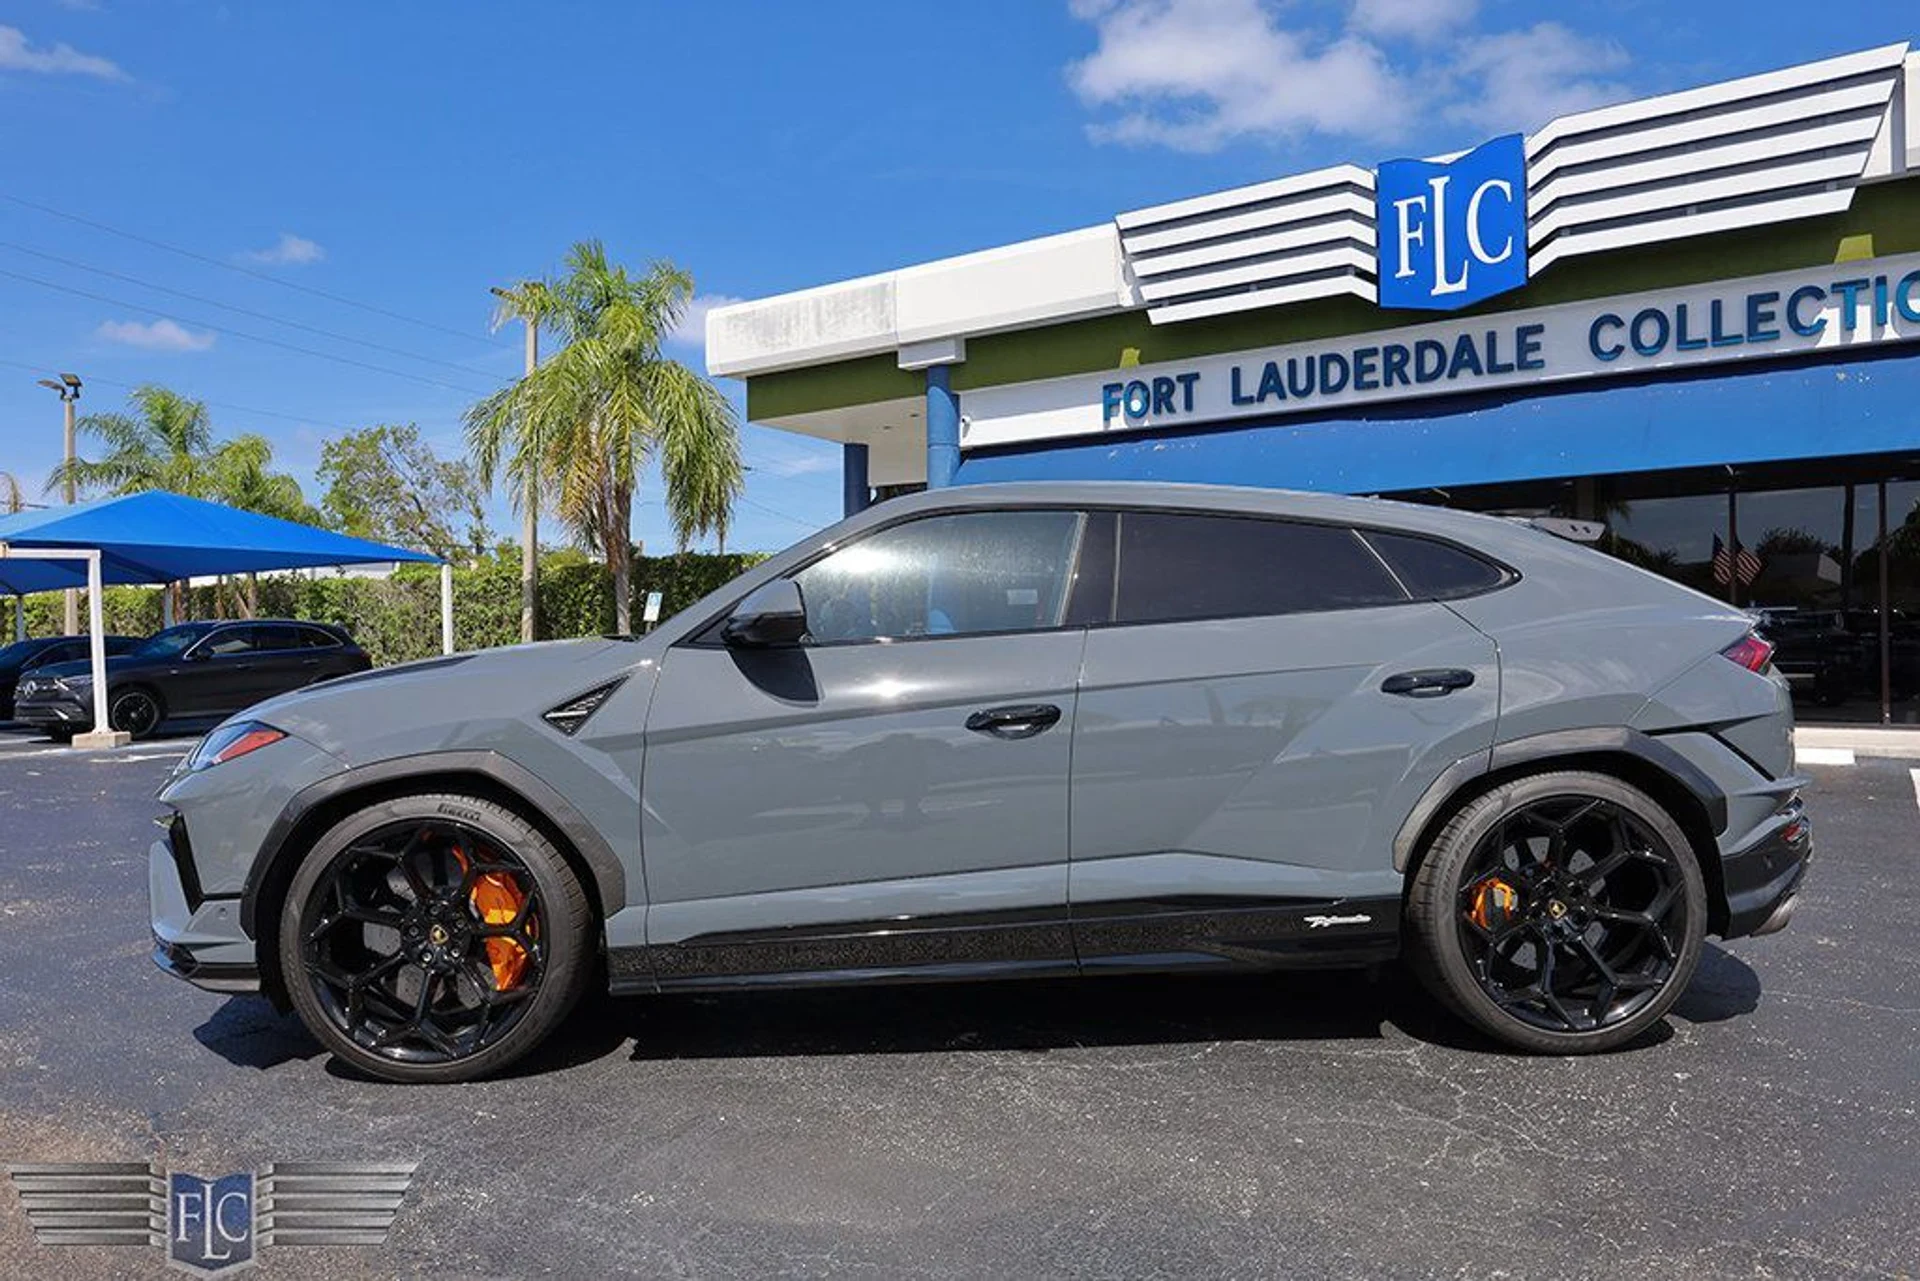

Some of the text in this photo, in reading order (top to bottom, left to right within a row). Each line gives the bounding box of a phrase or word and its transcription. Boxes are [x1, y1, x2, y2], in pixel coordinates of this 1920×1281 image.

[1394, 176, 1513, 297] FLC
[1102, 371, 1201, 422] FORT
[1231, 324, 1545, 405] LAUDERDALE
